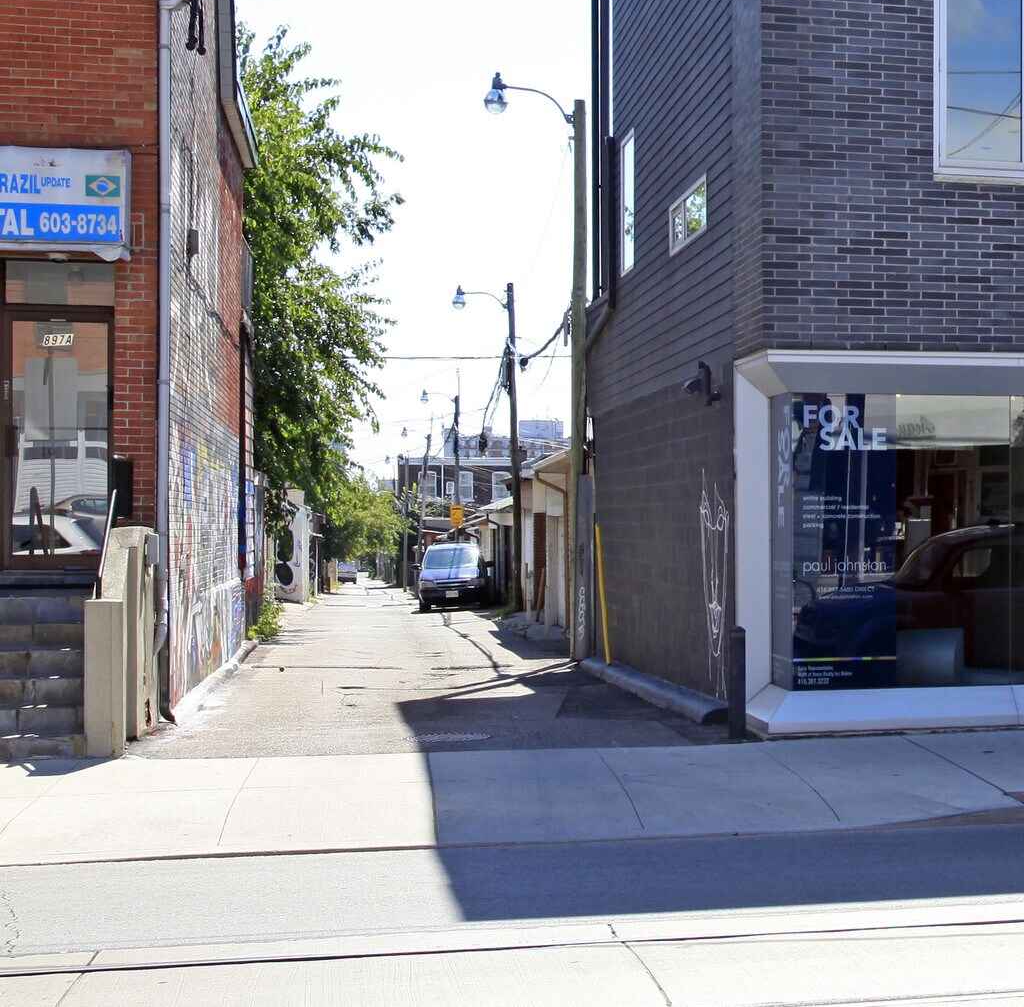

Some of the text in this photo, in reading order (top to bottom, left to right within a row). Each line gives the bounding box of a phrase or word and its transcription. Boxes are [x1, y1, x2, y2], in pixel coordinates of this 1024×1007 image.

[0, 173, 71, 194] RAZIL UPDATE
[40, 211, 117, 235] 603-8734
[44, 335, 72, 346] 897A
[803, 405, 860, 429] FOR
[819, 427, 887, 451] SALE
[802, 556, 887, 576] paul johnston
